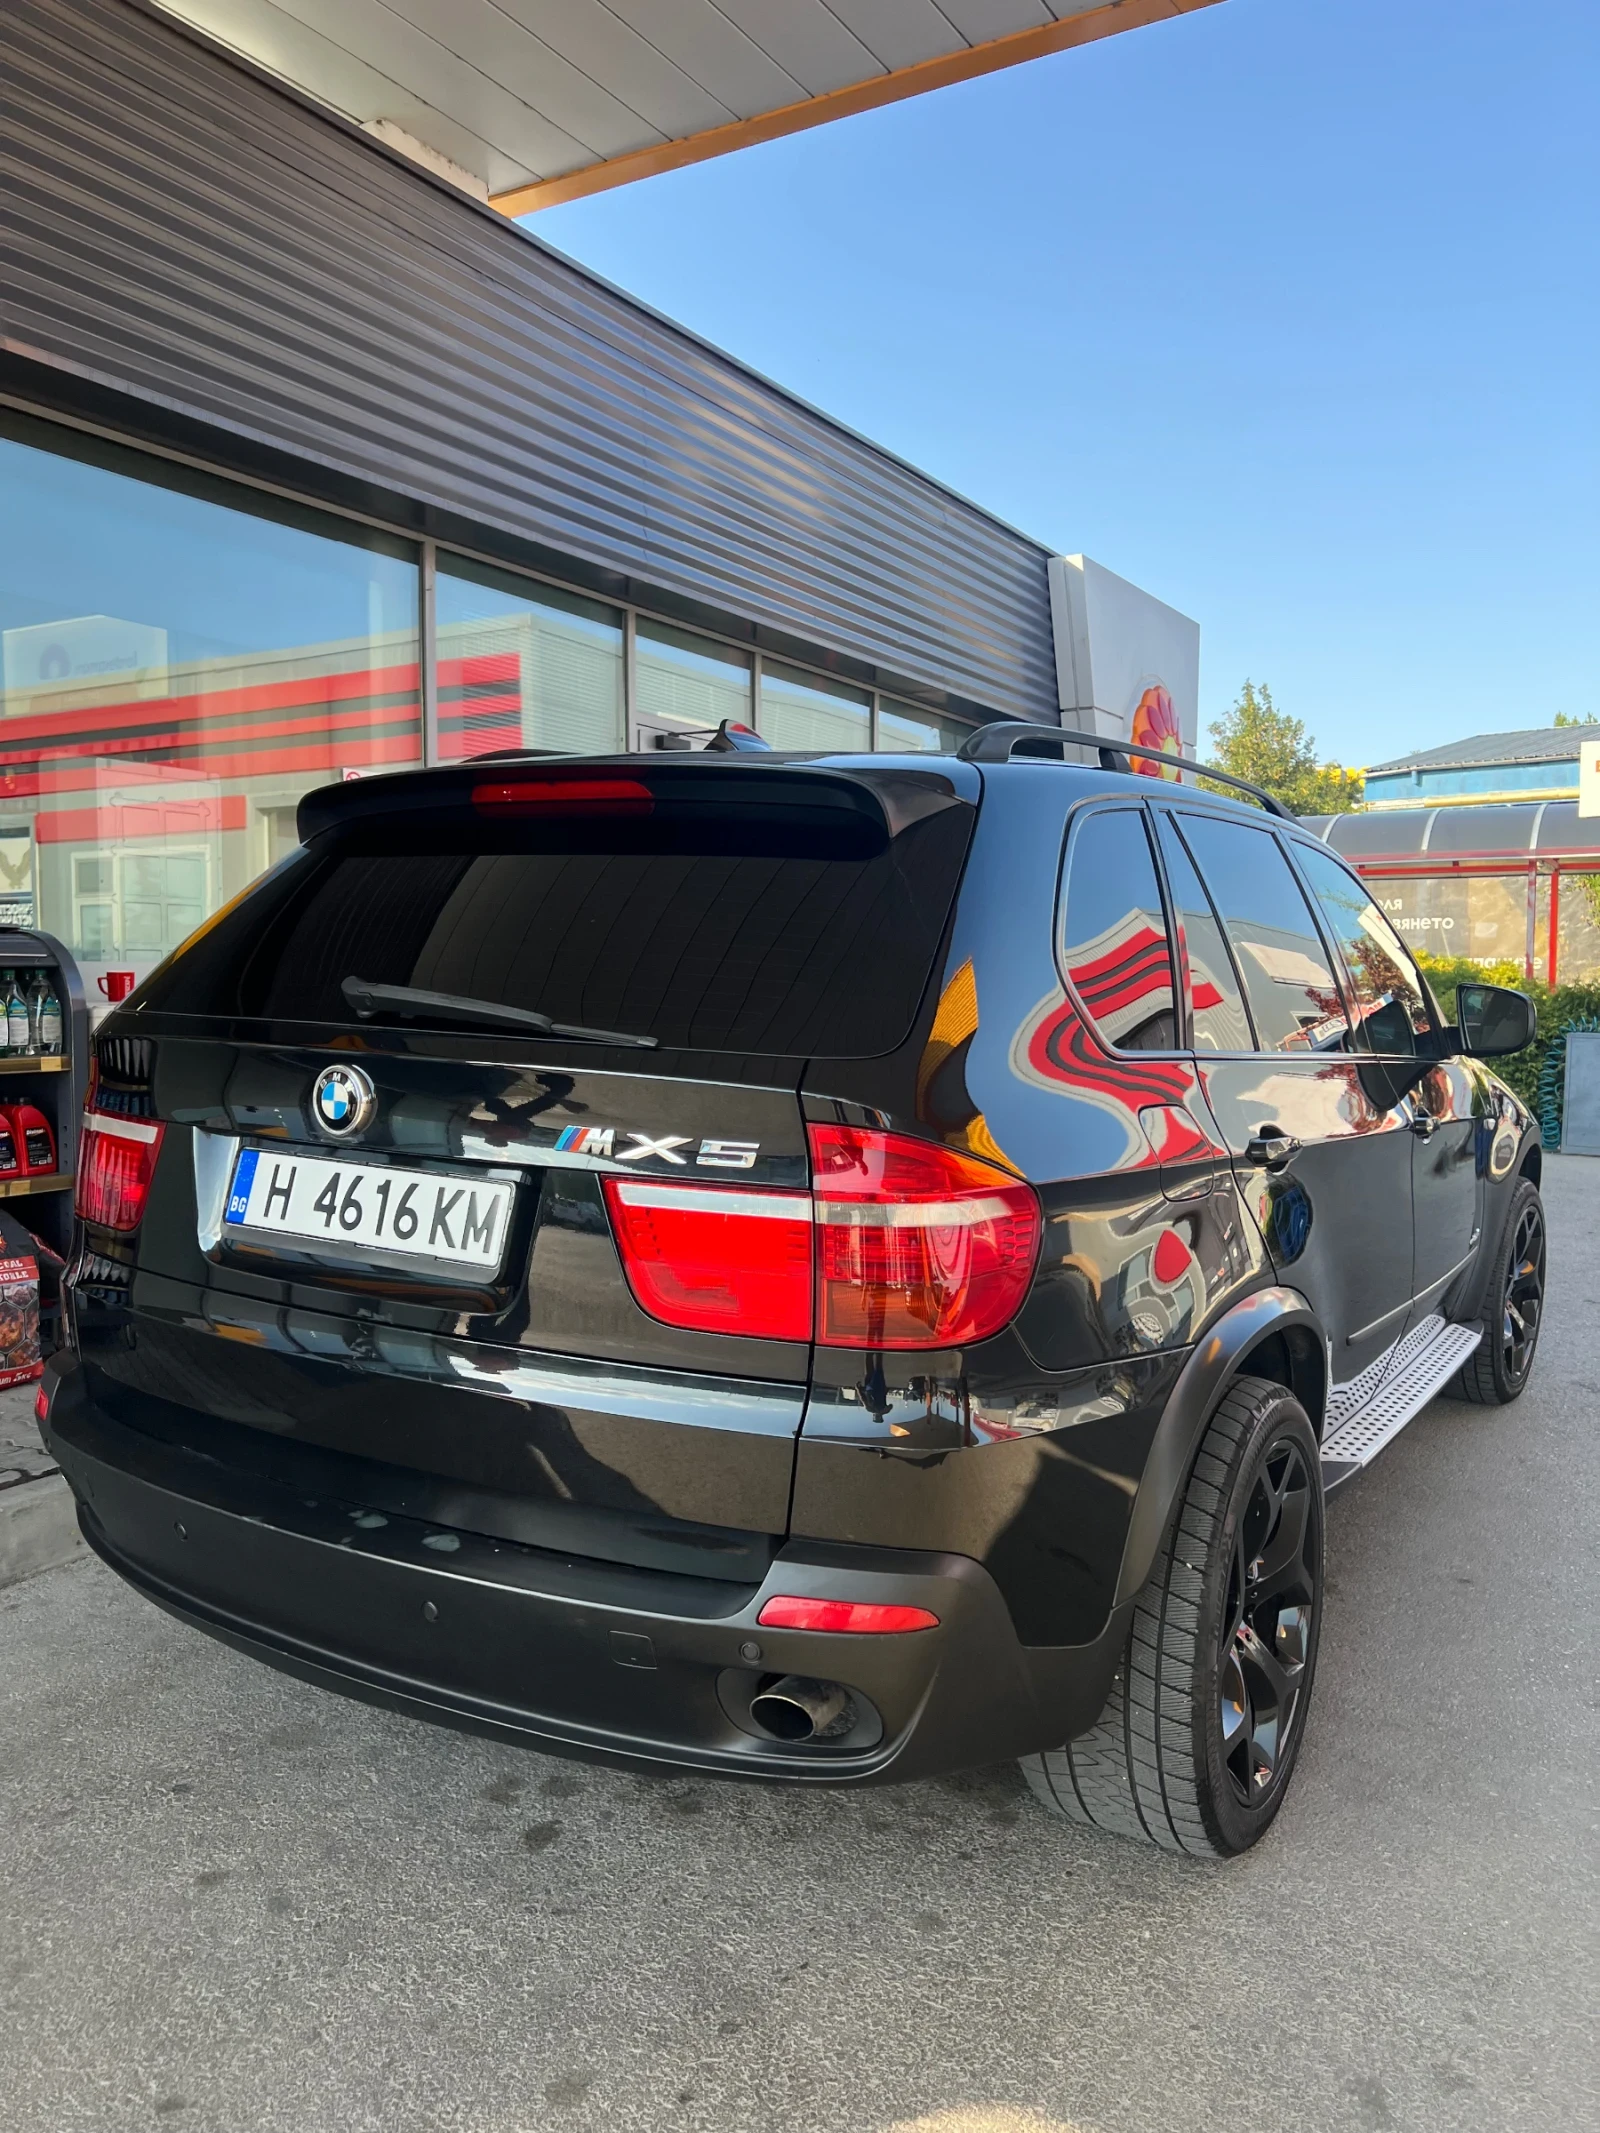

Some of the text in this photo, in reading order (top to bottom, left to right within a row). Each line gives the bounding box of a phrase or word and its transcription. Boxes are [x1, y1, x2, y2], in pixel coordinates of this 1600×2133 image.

[230, 1195, 247, 1214] BG
[263, 1164, 501, 1254] H 4616 KM
